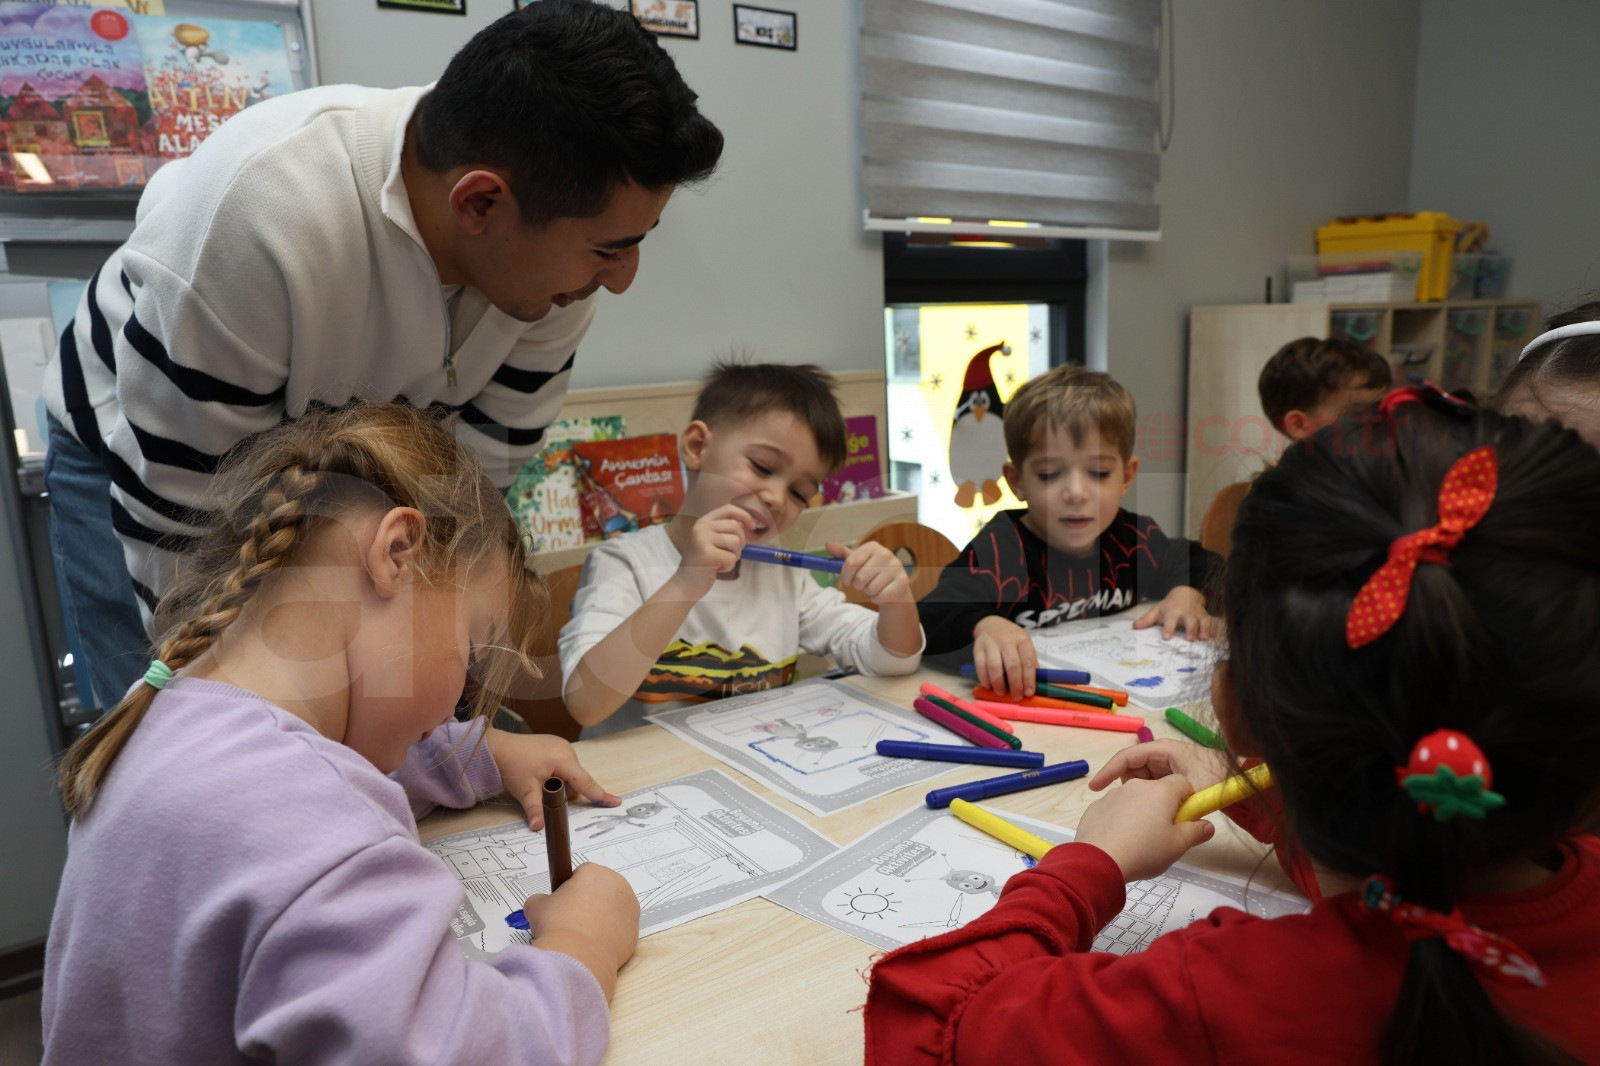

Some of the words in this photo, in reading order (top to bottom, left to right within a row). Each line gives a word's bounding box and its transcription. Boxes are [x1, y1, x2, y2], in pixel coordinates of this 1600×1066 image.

[601, 453, 671, 473] Annemin
[614, 469, 673, 490] Çantası
[870, 840, 914, 865] Boyama
